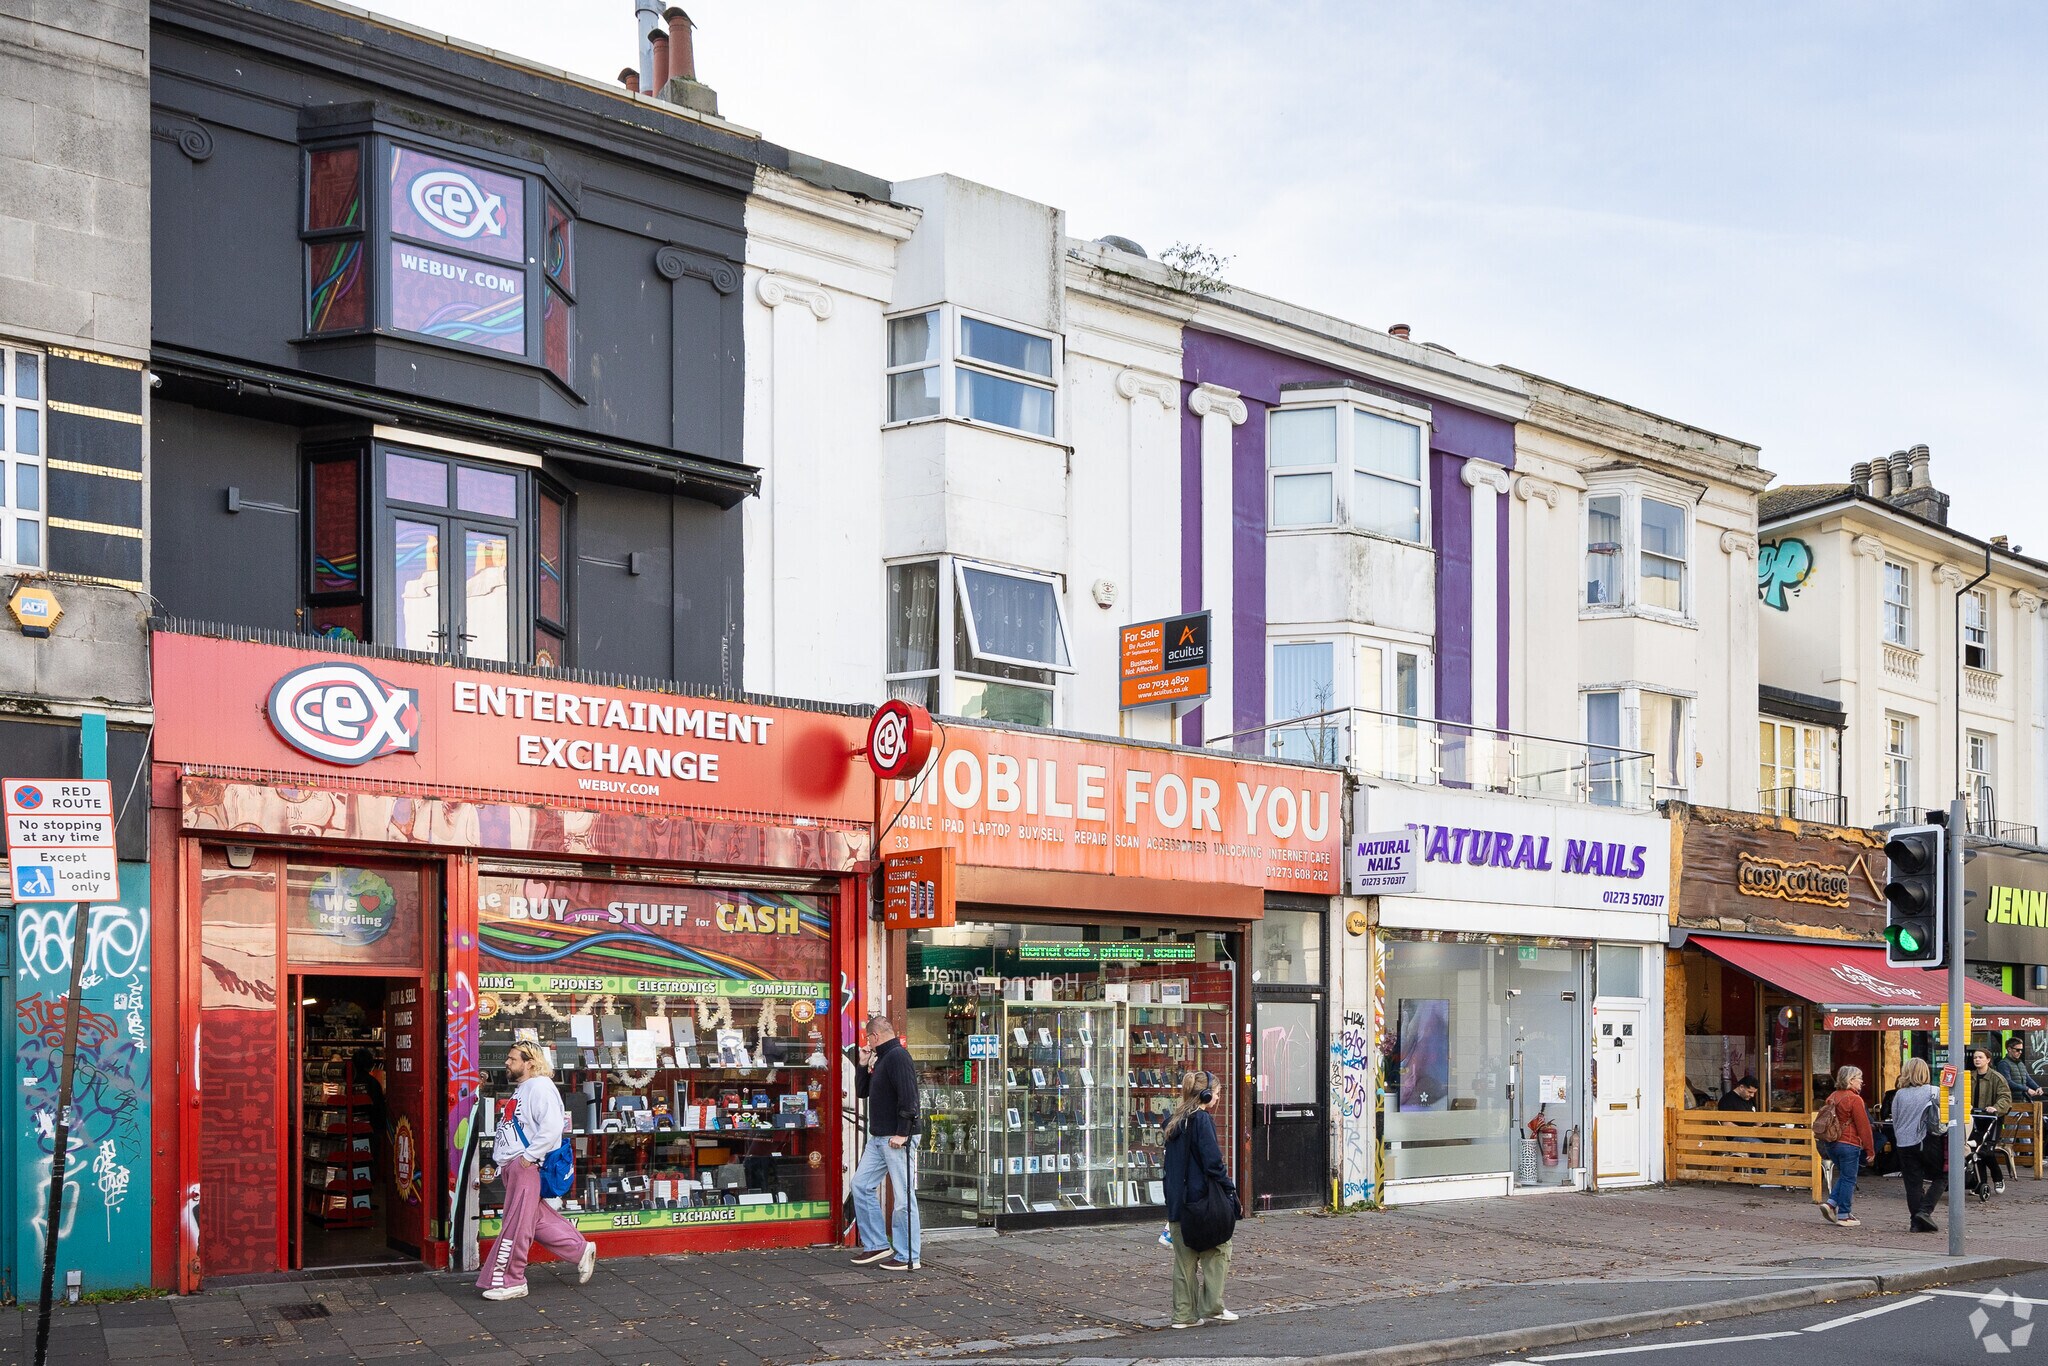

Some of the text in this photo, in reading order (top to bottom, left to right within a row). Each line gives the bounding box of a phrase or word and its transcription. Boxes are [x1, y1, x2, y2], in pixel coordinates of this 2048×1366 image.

[400, 253, 516, 294] WEBUY.COM
[22, 601, 46, 614] ADT
[1125, 628, 1160, 643] For Sale
[1136, 640, 1156, 649] Auction
[1168, 645, 1204, 660] acuitus
[1125, 664, 1159, 676] Not Affected
[1130, 658, 1154, 668] Business
[1137, 675, 1190, 690] 020 7034 4850
[453, 681, 774, 745] ENTERTAINMENT
[517, 734, 720, 783] EXCHANGE
[61, 786, 91, 797] RED
[578, 777, 660, 796] WEBUY.COM
[52, 798, 102, 809] ROUTE
[1125, 768, 1223, 832] FOR
[1236, 781, 1329, 842] YOU
[19, 819, 102, 832] No stopping
[23, 832, 100, 843] at any time
[895, 835, 909, 849] 33
[941, 818, 965, 834] IPAD
[972, 820, 1011, 838] LAPTOP
[1074, 830, 1108, 847] REPAIR
[1115, 833, 1140, 849] SCAN
[1146, 836, 1208, 854] ACCESSORIES
[1213, 842, 1263, 859] UNLOCKING
[1268, 847, 1309, 864] INTERNET
[1310, 851, 1331, 865] CAFE
[1357, 839, 1411, 857] NATURAL
[40, 852, 87, 863] Except
[1367, 856, 1401, 872] NAILS
[1561, 838, 1648, 880] NAILS
[59, 870, 111, 881] Loading
[1265, 865, 1293, 880] 01273
[1312, 869, 1329, 882] 282
[71, 882, 100, 893] only
[1361, 876, 1406, 887] 01273 570317
[324, 893, 358, 912] We
[1602, 890, 1665, 907] 01273 570317
[319, 912, 383, 929] Recycling
[509, 896, 569, 921] BUY
[575, 912, 600, 923] your
[607, 901, 688, 927] STUFF
[695, 918, 711, 928] for
[715, 902, 800, 935] CASH
[1353, 919, 1366, 929] Yale
[1063, 943, 1090, 957] cafe
[1100, 944, 1144, 960] printing
[550, 978, 603, 990] PHONES
[637, 980, 716, 994] ELECTRONICS
[749, 983, 819, 996] COMPUTING
[405, 988, 417, 1003] SELL
[394, 1011, 413, 1026] PHONES
[1833, 1016, 1872, 1027] Breakfast
[1887, 1016, 1920, 1027] Omelette
[1997, 1016, 2010, 1027] Tea
[2020, 1016, 2042, 1027] Coffee
[396, 1034, 412, 1049] GAMES
[401, 1057, 412, 1072] TECH
[612, 1214, 641, 1226] SELL
[672, 1209, 736, 1223] EXCHANGE
